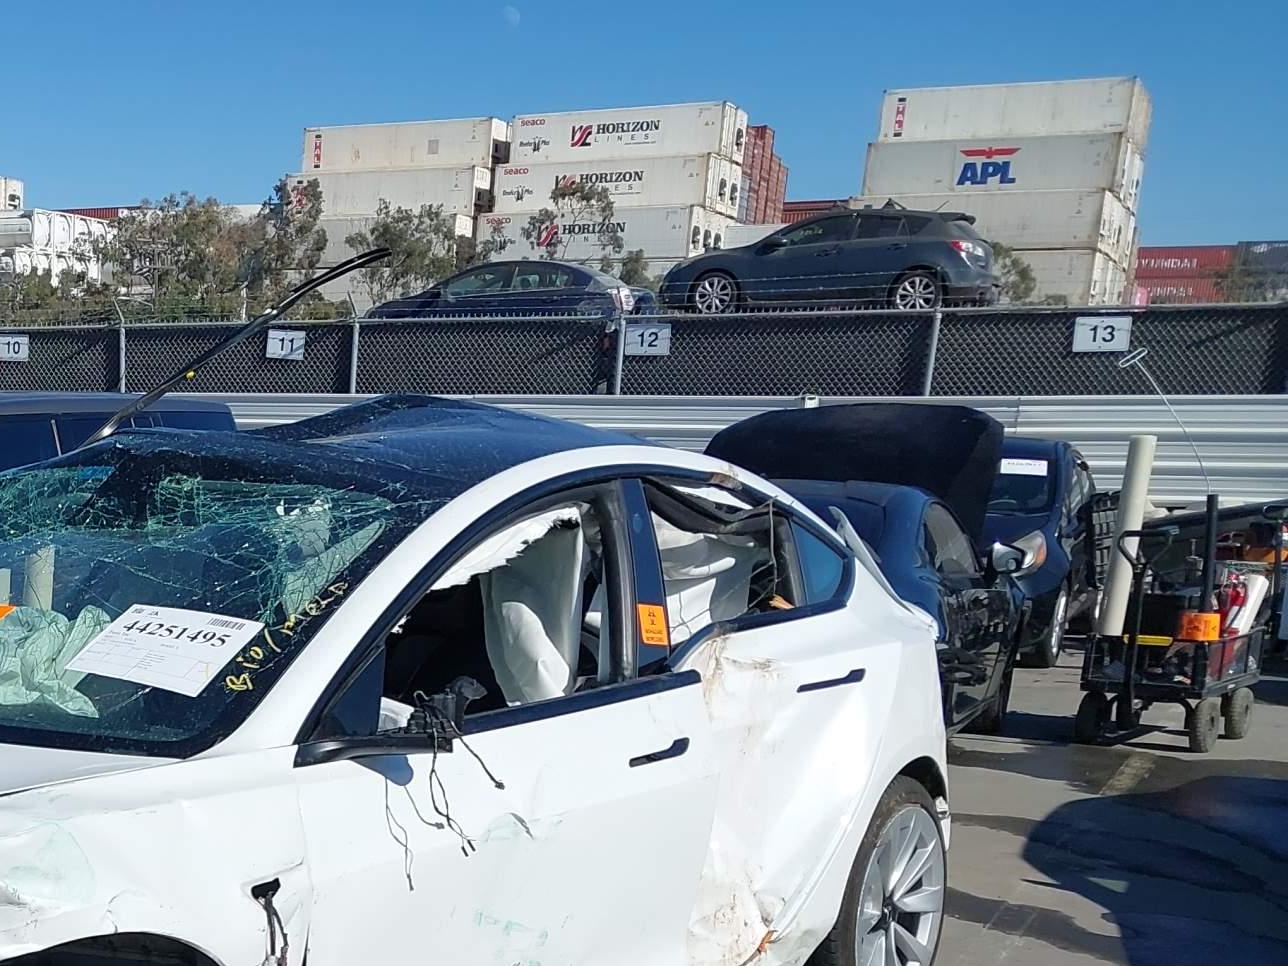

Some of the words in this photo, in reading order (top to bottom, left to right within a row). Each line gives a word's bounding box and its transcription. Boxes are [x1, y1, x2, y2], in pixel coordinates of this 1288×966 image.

[520, 119, 546, 127] seaco
[894, 103, 905, 130] TAL
[596, 120, 661, 135] HORIZON
[594, 133, 650, 143] LINES
[313, 140, 322, 164] TAL
[503, 167, 529, 176] seaco
[579, 170, 644, 185] HORIZON
[956, 160, 1016, 185] APL
[486, 217, 511, 225] seaco
[562, 221, 626, 236] HORIZON
[637, 331, 659, 348] 12
[1089, 324, 1116, 343] 13
[7, 340, 21, 355] 10
[278, 336, 295, 353] 11
[122, 619, 232, 648] 44251495
